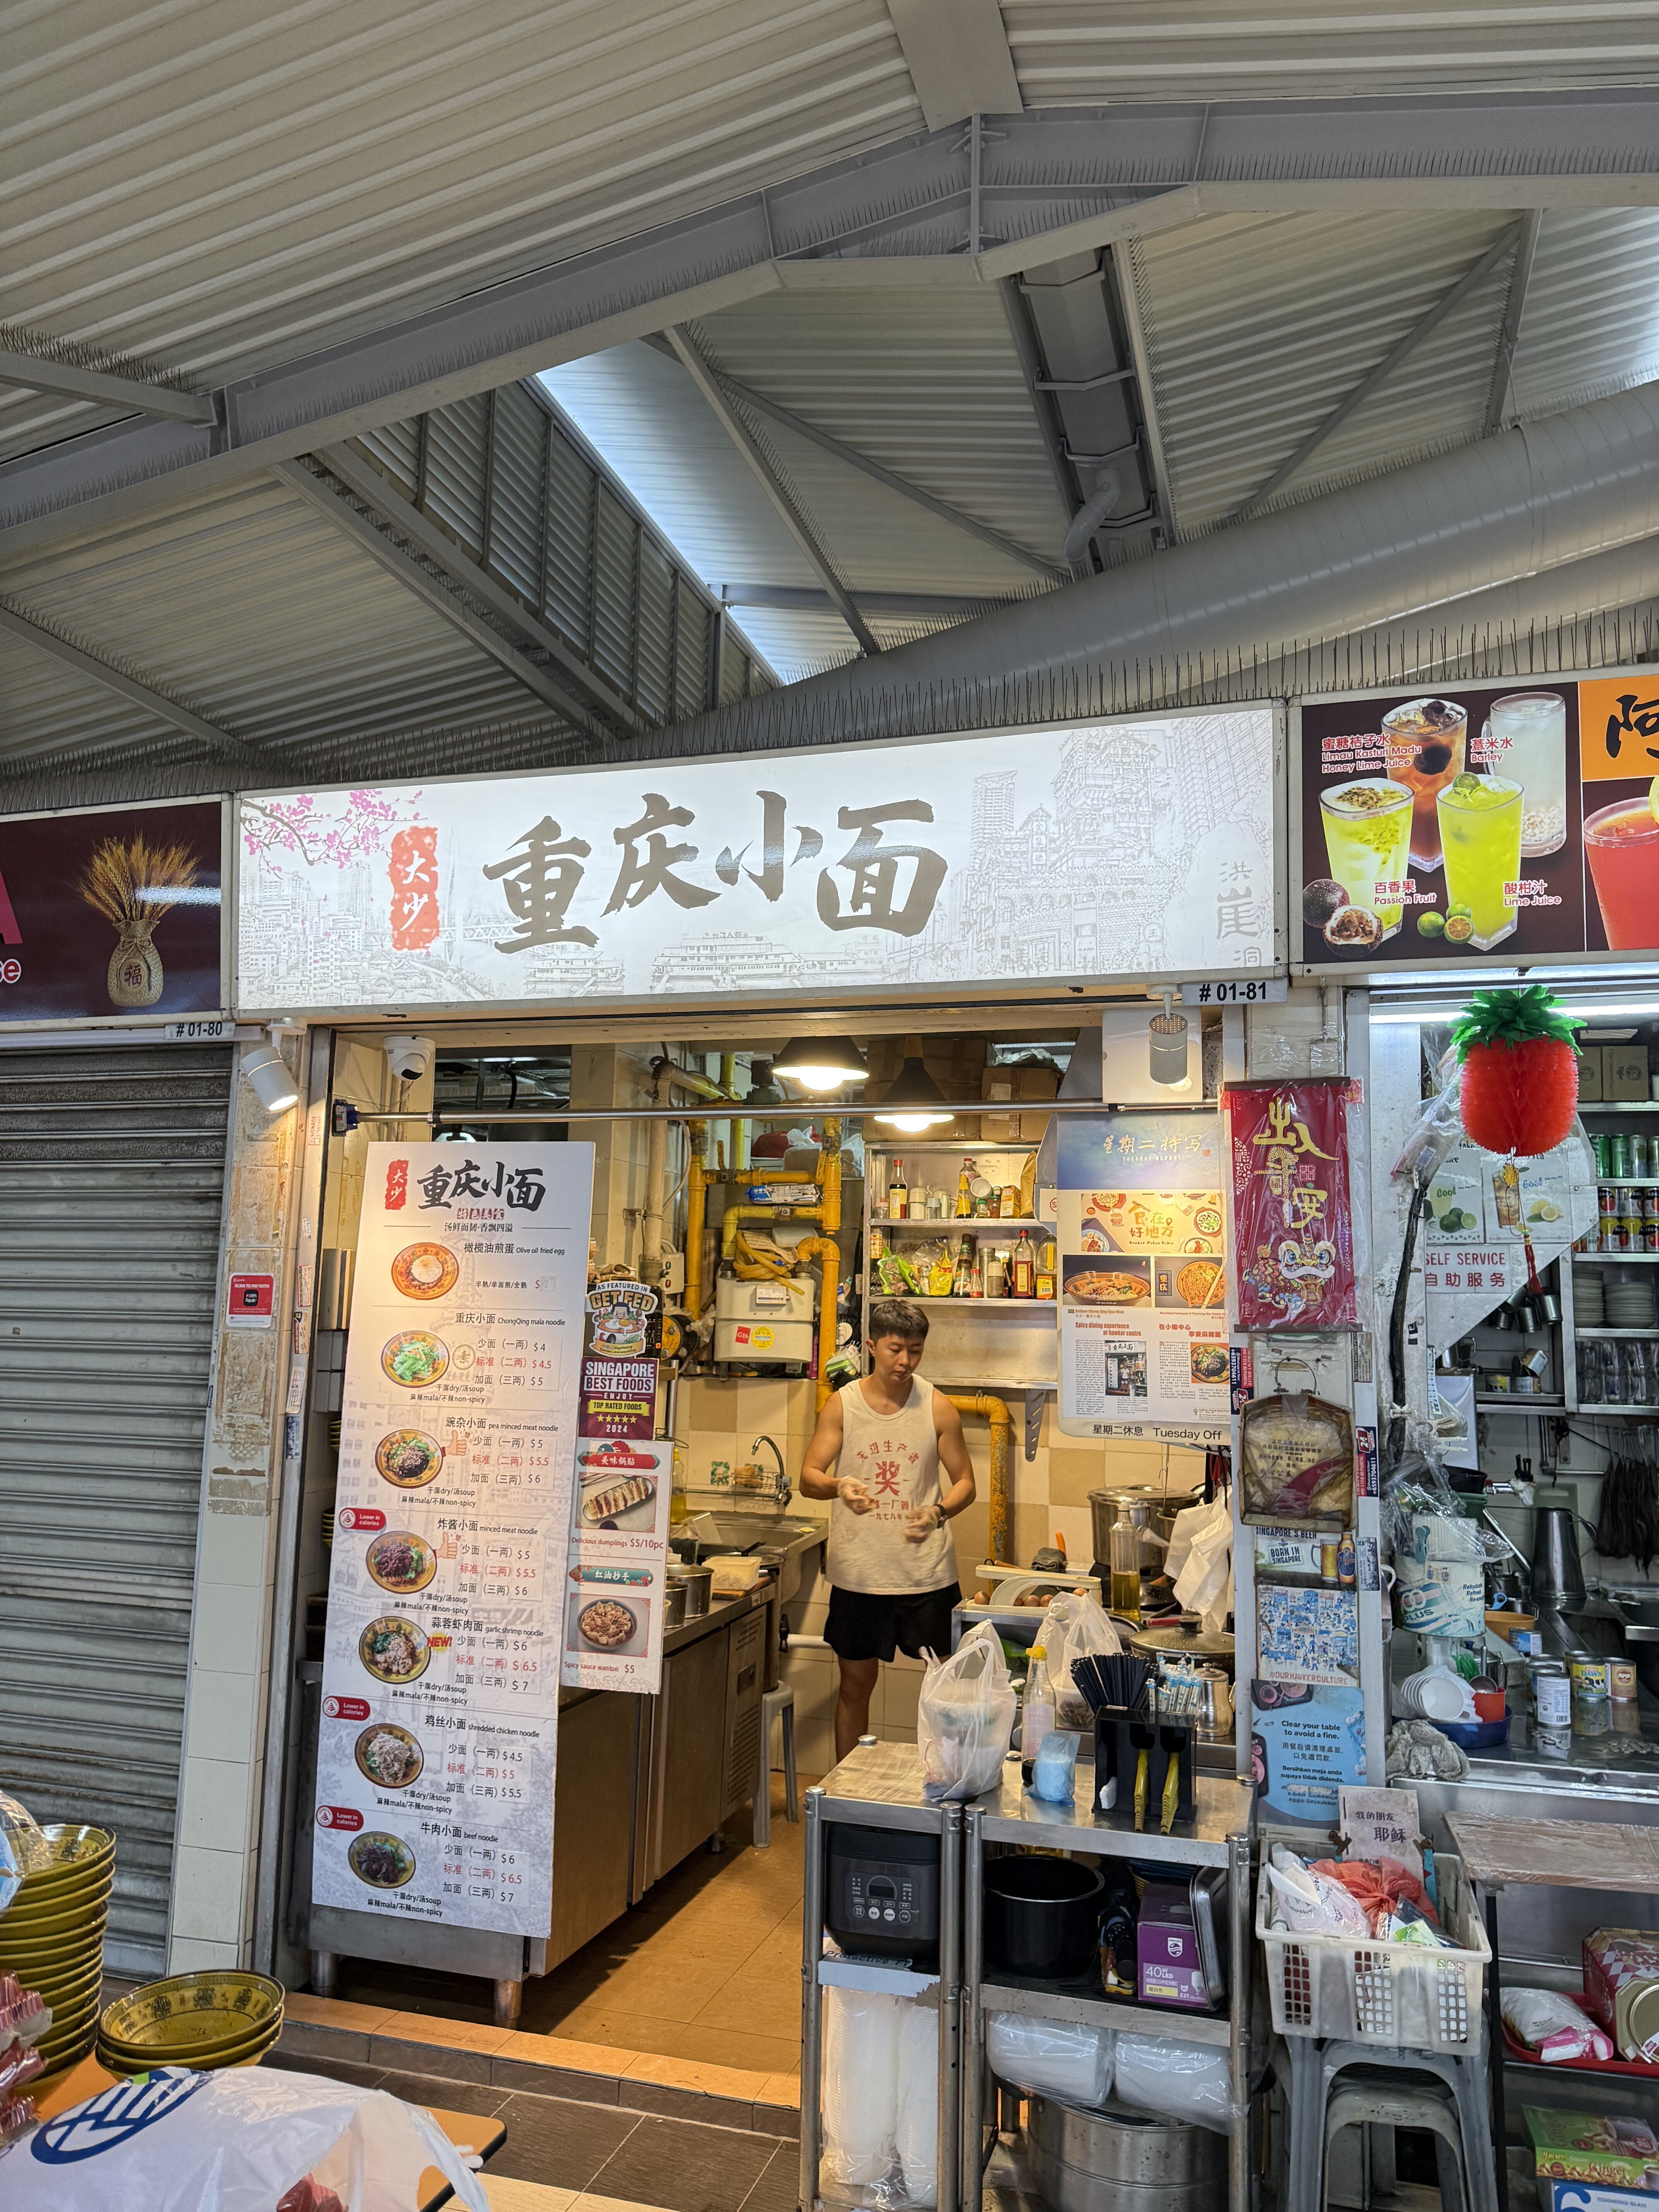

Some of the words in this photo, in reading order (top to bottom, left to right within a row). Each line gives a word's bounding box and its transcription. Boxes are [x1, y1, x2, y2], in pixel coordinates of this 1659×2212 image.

[1322, 734, 1390, 750] 蜜糖桔子水
[1322, 749, 1353, 762] Limau
[1355, 747, 1389, 759] Kasturi
[1391, 744, 1422, 756] Madu
[1470, 752, 1503, 764] Barley
[1322, 763, 1354, 773] Honey
[1356, 759, 1381, 770] Lime
[1383, 757, 1411, 768] Juice
[483, 790, 948, 955] 重庆小面
[402, 849, 431, 931] 大少
[1374, 879, 1416, 894] 百香果
[1503, 880, 1547, 895] 酸柑汁
[1374, 894, 1412, 905] Passion
[1413, 892, 1436, 904] Fruit
[1503, 896, 1529, 907] Lime
[1531, 895, 1562, 906] Juice
[124, 965, 142, 986] 福
[1199, 984, 1211, 1001] #
[1216, 982, 1267, 1002] 01-81
[176, 1022, 184, 1037] #
[188, 1022, 222, 1037] 01-80
[1103, 1134, 1203, 1155] 星期二特写
[392, 1170, 404, 1202] 大少
[417, 1159, 546, 1211] 重庆小面
[457, 1208, 504, 1219] 特色美食
[464, 1243, 514, 1254] 橄榄油煎蛋
[1457, 1252, 1506, 1265] SERVICE
[1425, 1272, 1506, 1287] 自助服务
[591, 1291, 620, 1309] GET
[623, 1292, 654, 1310] FED
[455, 1313, 495, 1324] 重庆小面
[498, 1317, 529, 1326] ChongQing
[457, 1349, 471, 1364] 素
[586, 1361, 654, 1377] SINGAPORE
[586, 1377, 613, 1389] BEST
[616, 1378, 651, 1391] FOODS
[446, 1417, 487, 1428] 豌杂小面
[606, 1424, 627, 1433] 2024
[1092, 1424, 1144, 1437] 星期二休息
[1153, 1427, 1200, 1441] Tuesday
[1203, 1430, 1222, 1440] Off
[875, 1461, 900, 1496] 奖
[438, 1518, 477, 1531] 炸酱小面
[598, 1539, 627, 1547] dumplings
[630, 1539, 663, 1550] $5/10pc
[1271, 1547, 1289, 1558] BORN
[1291, 1547, 1300, 1556] IN
[1272, 1555, 1301, 1565] SINGAPORE
[595, 1570, 629, 1581] 红油抄手
[1403, 1609, 1434, 1621] PLUS
[432, 1617, 483, 1632] 蒜蓉虾肉面
[503, 1628, 522, 1636] shrimp
[427, 1637, 452, 1647] NEW!
[624, 1664, 634, 1673] $5
[1269, 1671, 1348, 1685] #OURHAWKERCULTURE
[425, 1715, 466, 1730] 鸡丝小面
[468, 1724, 495, 1733] shredded
[496, 1726, 518, 1736] chicken
[519, 1729, 539, 1738] noodle
[1355, 1811, 1395, 1821] 我的朋友
[421, 1822, 462, 1838] 牛肉小面
[478, 1834, 498, 1843] noodle
[1374, 1827, 1406, 1843] 耶稣
[826, 1951, 889, 1965] Protective
[1146, 1966, 1162, 1977] 40
